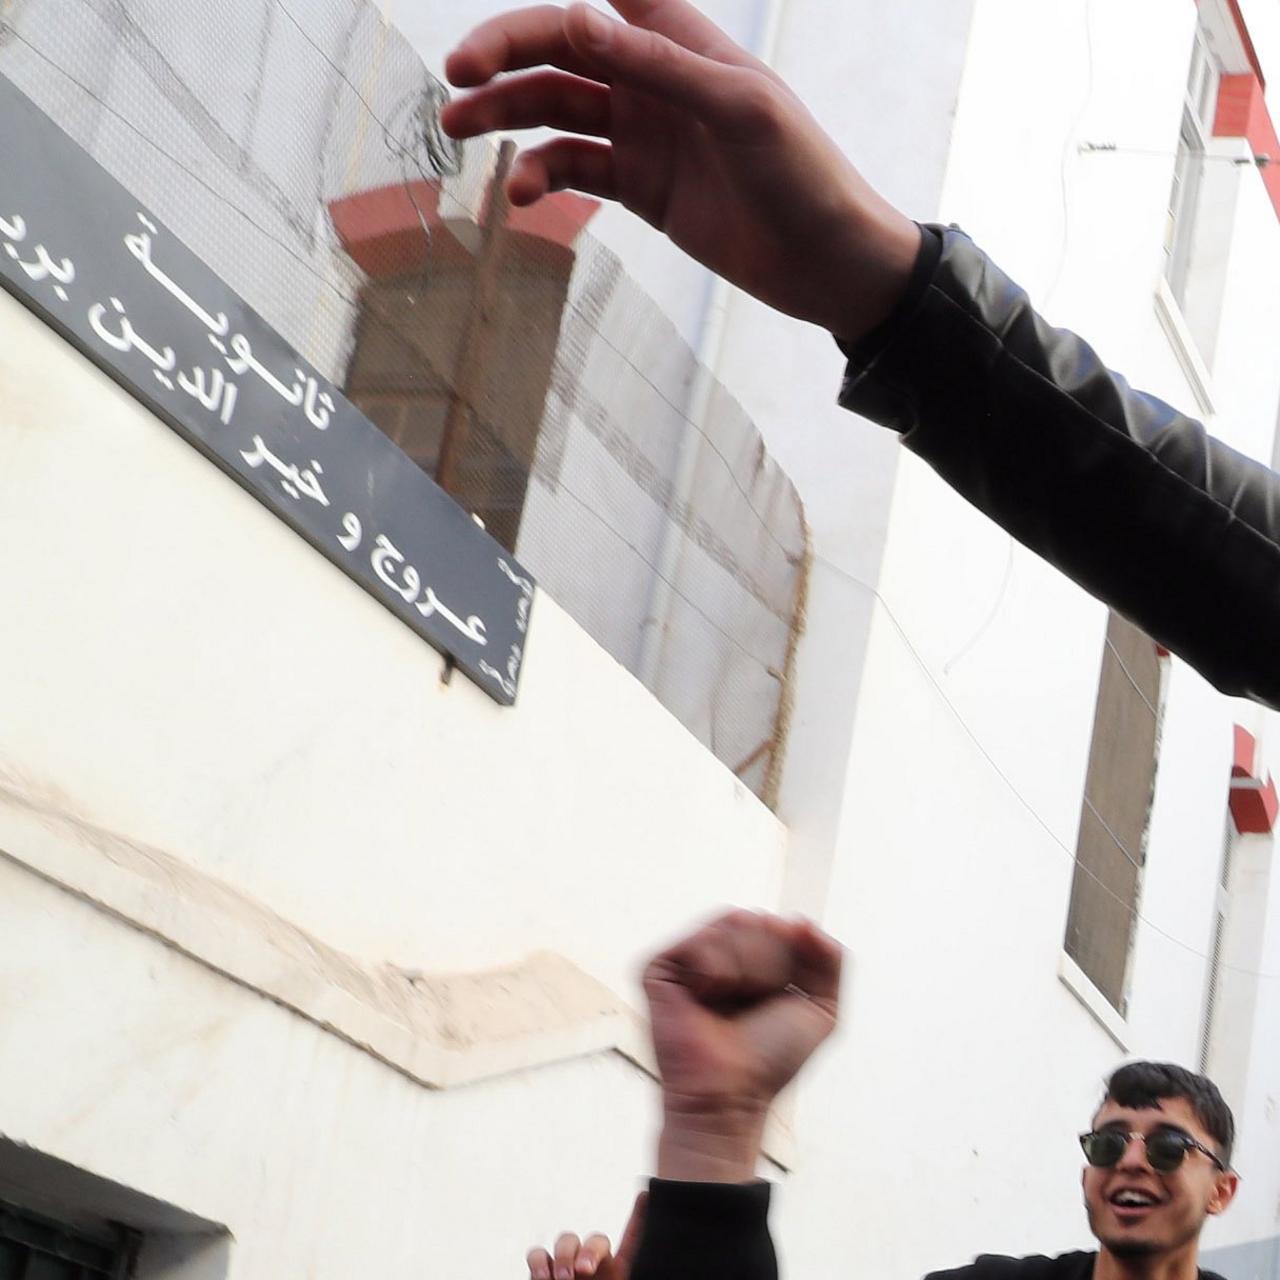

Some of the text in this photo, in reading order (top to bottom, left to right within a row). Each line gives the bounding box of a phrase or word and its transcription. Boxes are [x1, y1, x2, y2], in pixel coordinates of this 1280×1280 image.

[87, 296, 239, 425] الدين
[239, 435, 331, 507] خير
[336, 512, 362, 551] و
[370, 533, 488, 646] عروج
